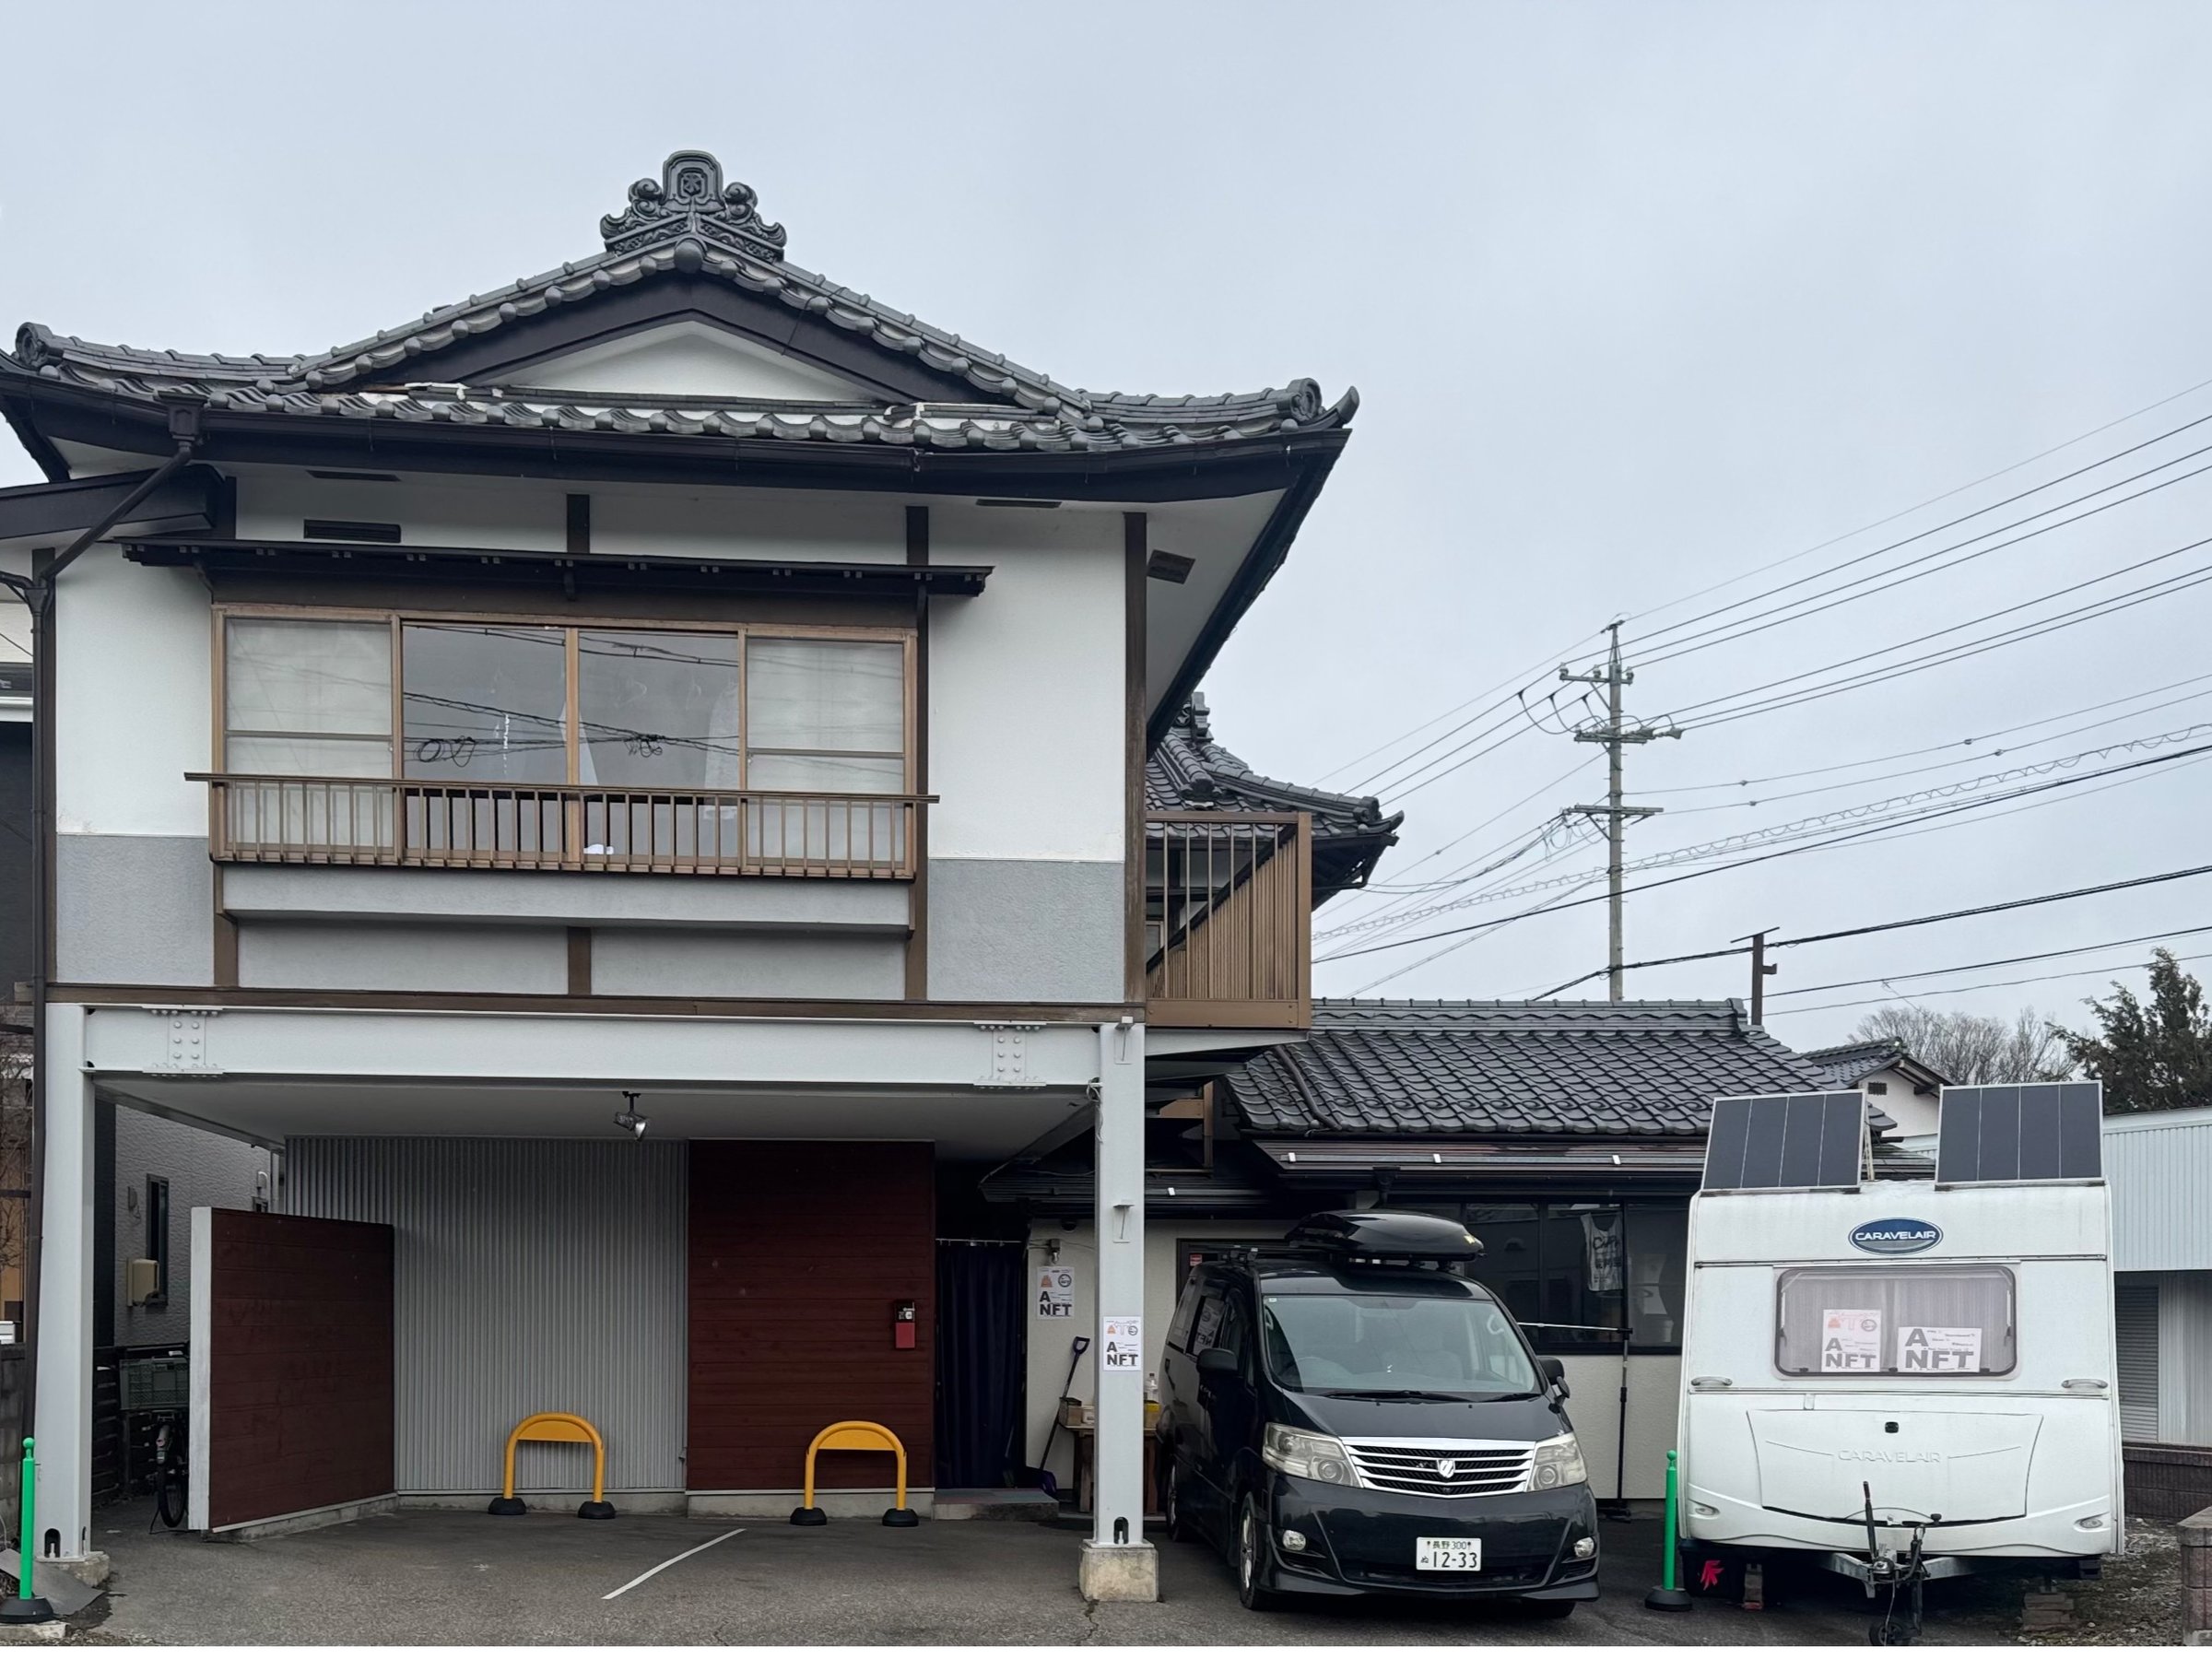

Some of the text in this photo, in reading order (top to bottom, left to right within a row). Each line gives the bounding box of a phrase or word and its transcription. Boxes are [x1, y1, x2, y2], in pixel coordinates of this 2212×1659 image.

[1855, 1231, 1936, 1241] CARAVELAIR
[1040, 1291, 1051, 1301] A
[1040, 1304, 1072, 1315] NFT
[1905, 1328, 1929, 1347] A
[1107, 1342, 1117, 1352] A
[1825, 1337, 1842, 1351] A
[1107, 1354, 1138, 1365] NFT
[1826, 1354, 1877, 1368] NFT
[1905, 1350, 1974, 1368] NFT
[1839, 1450, 1940, 1463] CARAVELAIR
[1452, 1541, 1466, 1549] 300
[1433, 1551, 1477, 1568] 12-33
